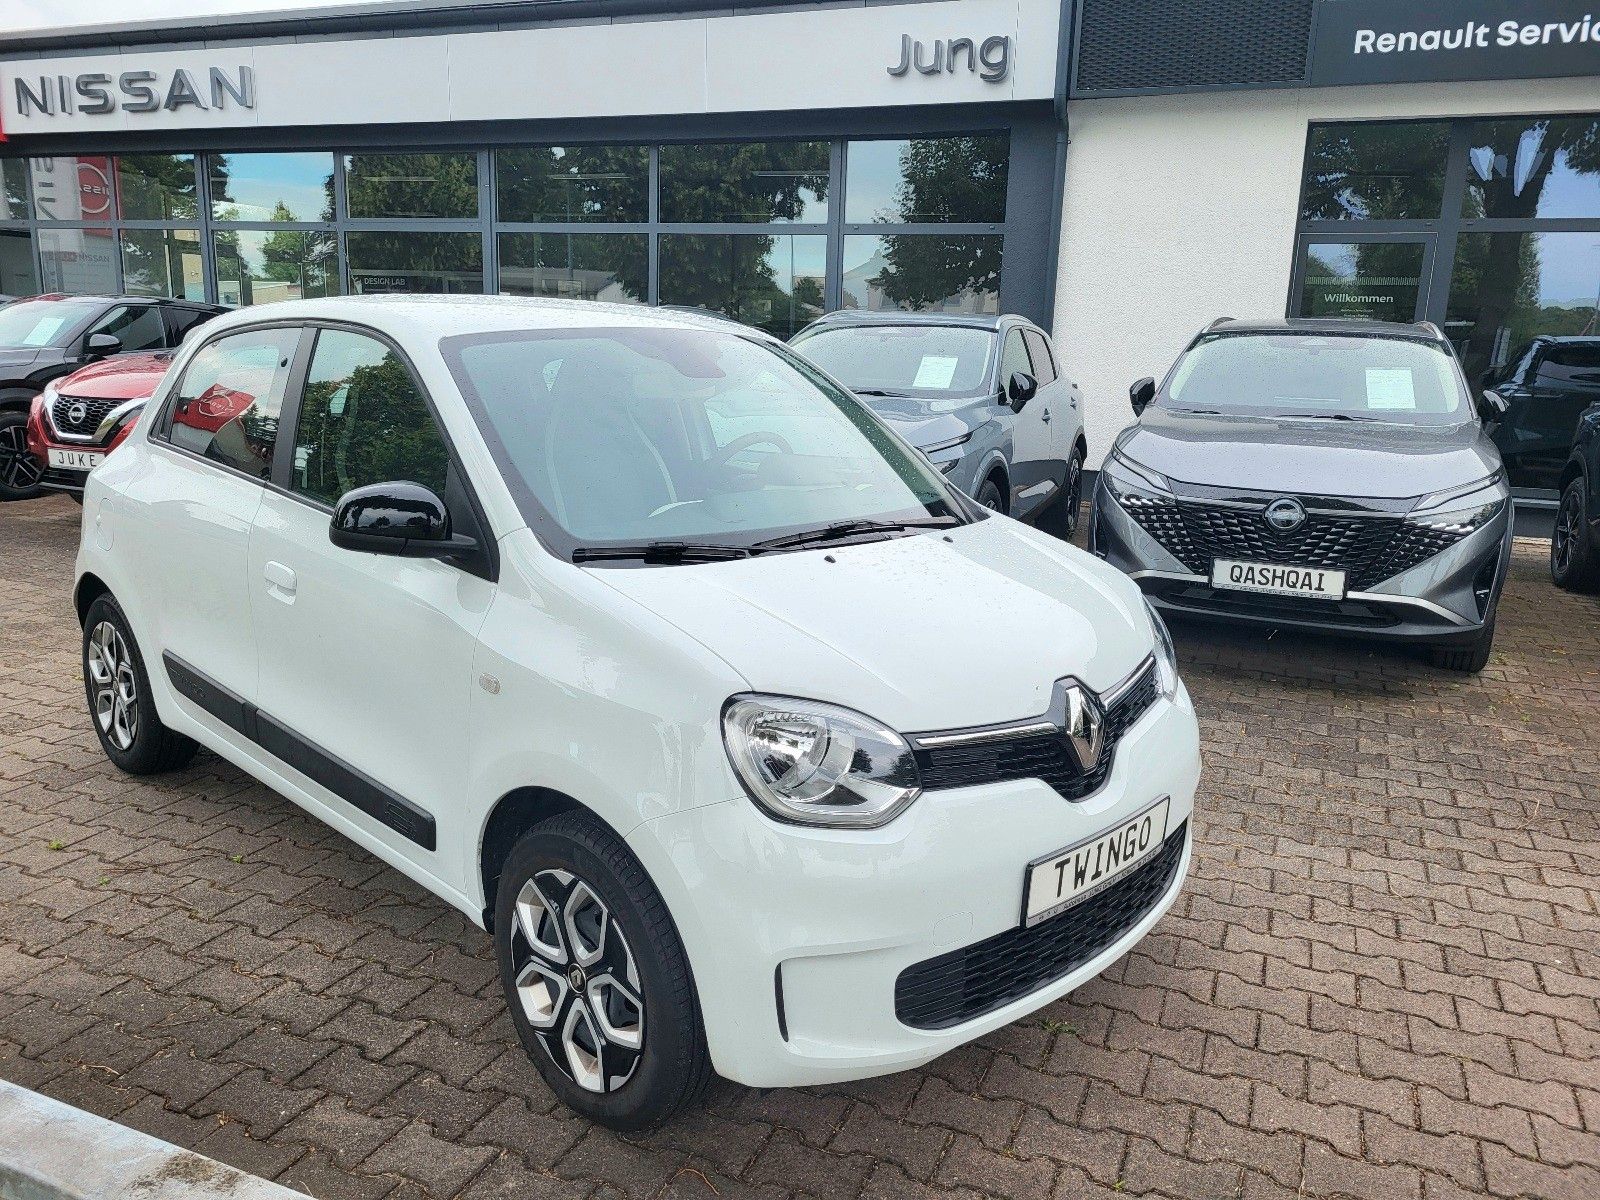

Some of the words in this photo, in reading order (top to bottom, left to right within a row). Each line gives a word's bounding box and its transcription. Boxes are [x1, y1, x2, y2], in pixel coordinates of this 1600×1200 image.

[1354, 21, 1490, 54] Renault
[886, 33, 1010, 82] Jung
[15, 65, 254, 117] NISSAN
[364, 277, 390, 285] DESIGN
[391, 278, 406, 286] LAB
[1324, 293, 1394, 303] Willkommen
[58, 451, 96, 467] JUKE
[1229, 564, 1325, 592] QASHQAI
[1054, 815, 1152, 898] TWINGO
